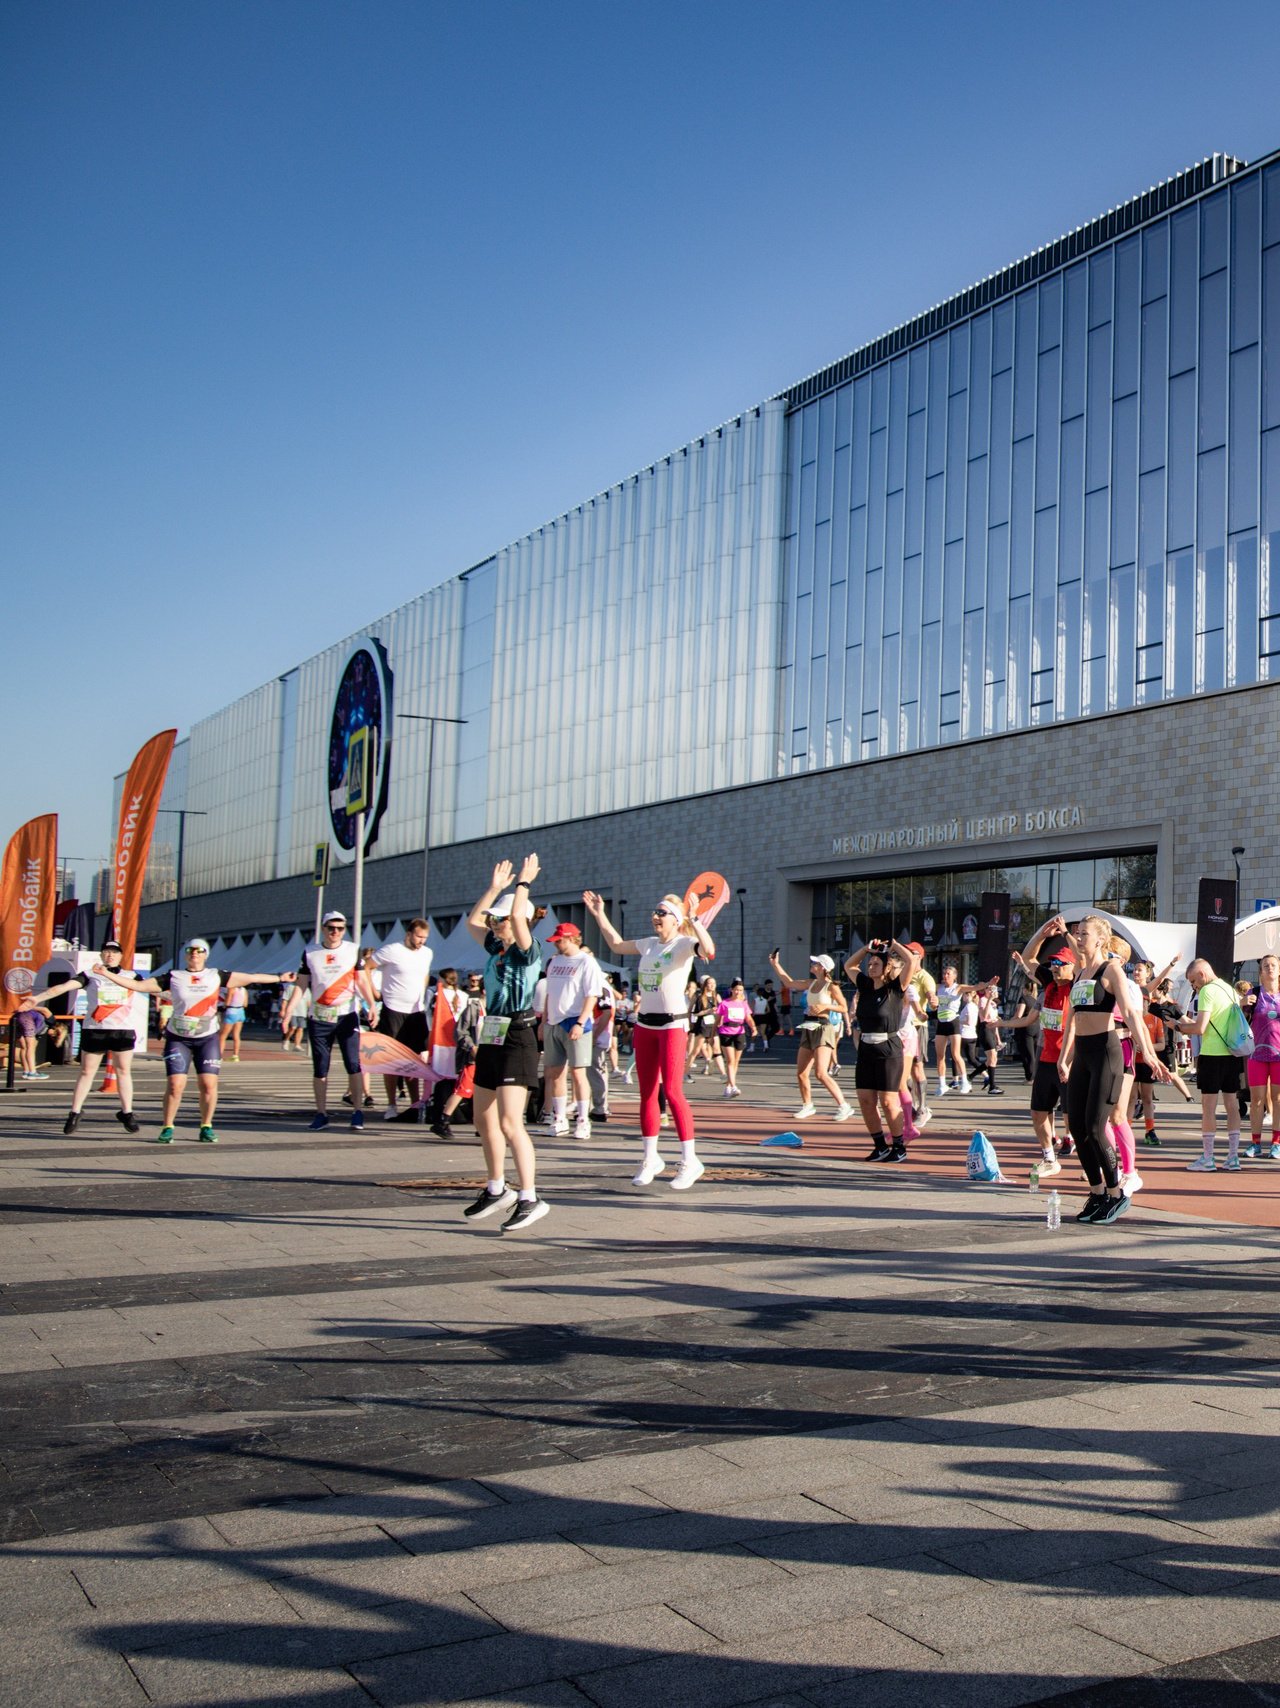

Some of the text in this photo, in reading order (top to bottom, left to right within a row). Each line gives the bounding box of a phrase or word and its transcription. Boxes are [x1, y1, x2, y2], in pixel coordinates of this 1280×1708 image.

[832, 806, 1082, 855] МЕЖДУНАРОДНЫЙ ЦЕНТР БОКСА
[13, 857, 42, 962] Велобайк
